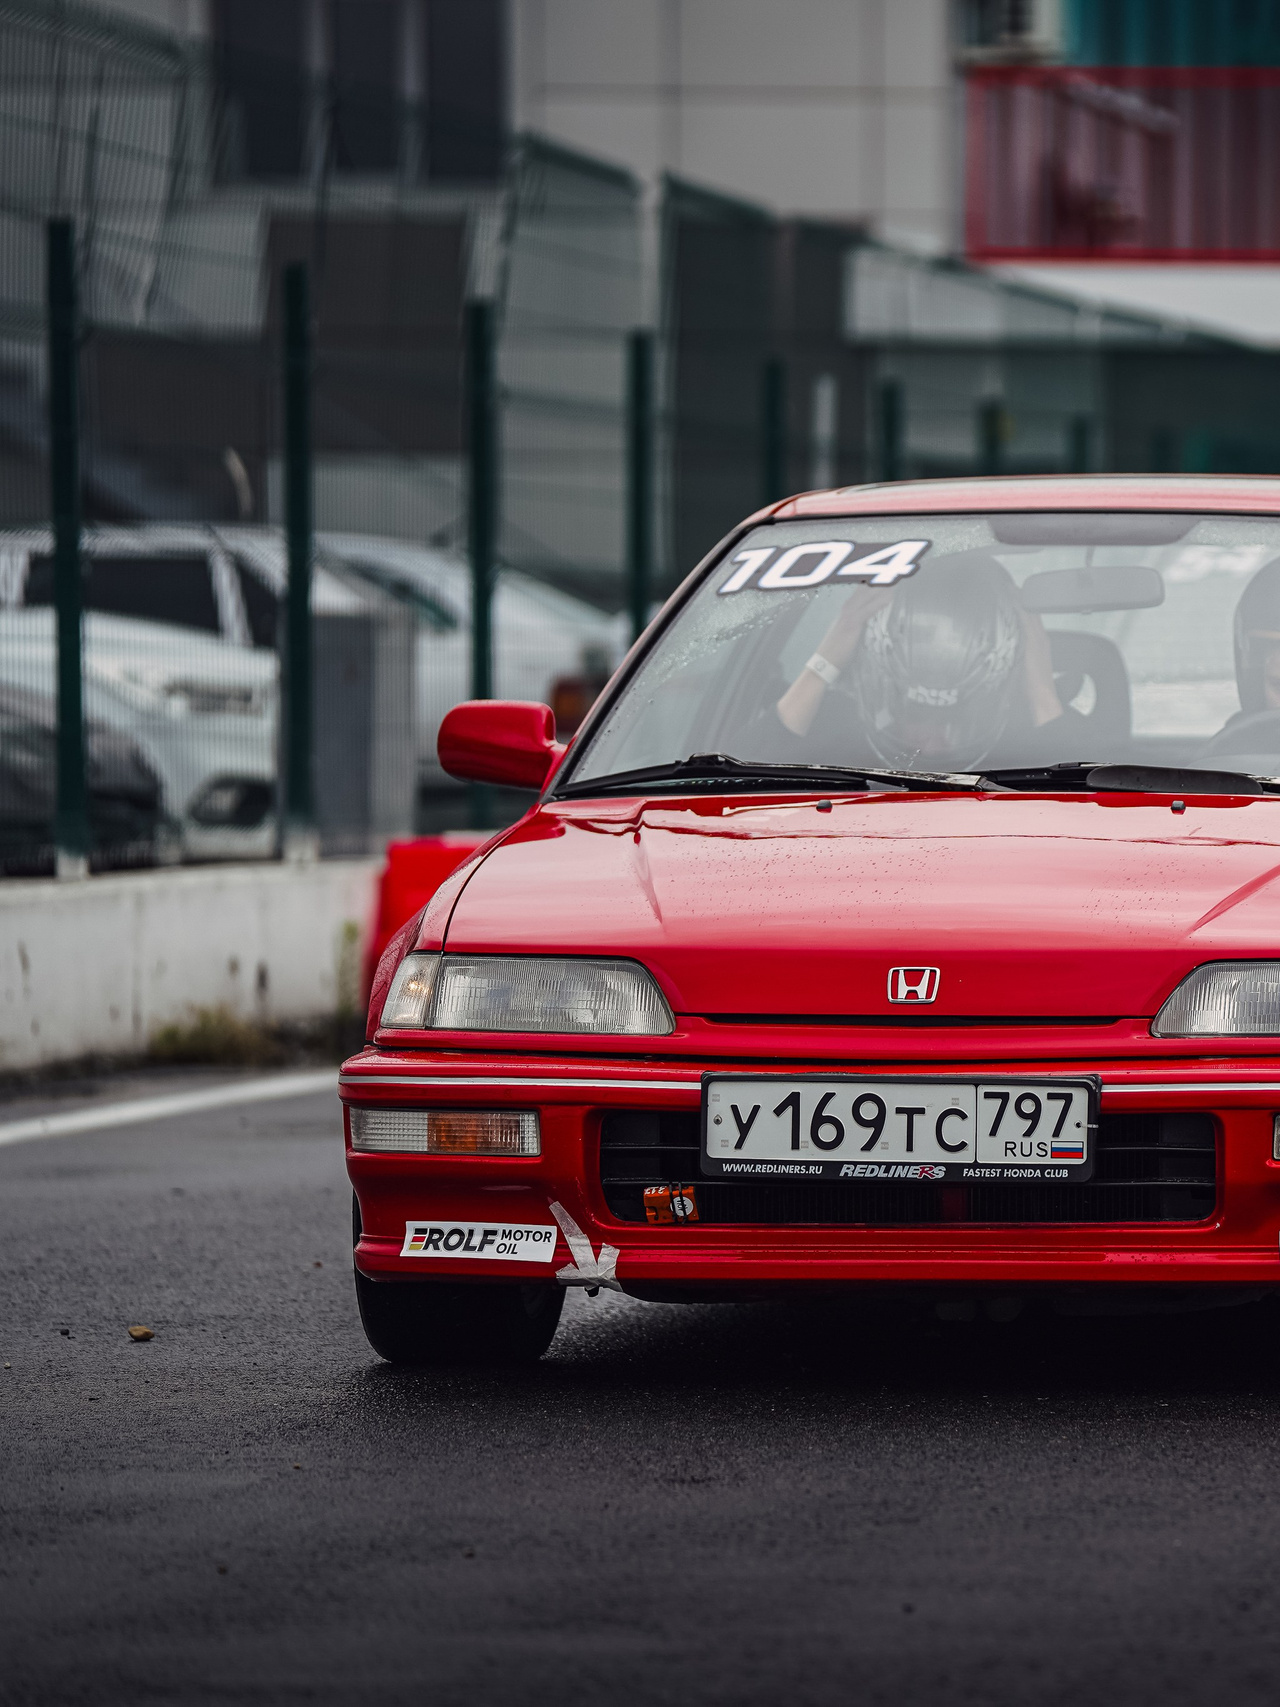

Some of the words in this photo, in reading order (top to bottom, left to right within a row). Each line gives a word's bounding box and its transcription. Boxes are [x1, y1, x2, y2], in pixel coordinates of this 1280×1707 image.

[718, 540, 930, 595] 104
[983, 1091, 1074, 1138] 797
[1004, 1141, 1048, 1158] RUS
[722, 1163, 823, 1175] WWW.REDLINERS.RU
[839, 1164, 946, 1179] REDLINERS
[963, 1168, 1001, 1177] FASTEST
[1003, 1168, 1041, 1177] HONDA
[1044, 1168, 1069, 1178] CLUB
[422, 1228, 498, 1252] ROLF
[500, 1229, 552, 1243] MOTOR
[496, 1243, 519, 1255] OIL
